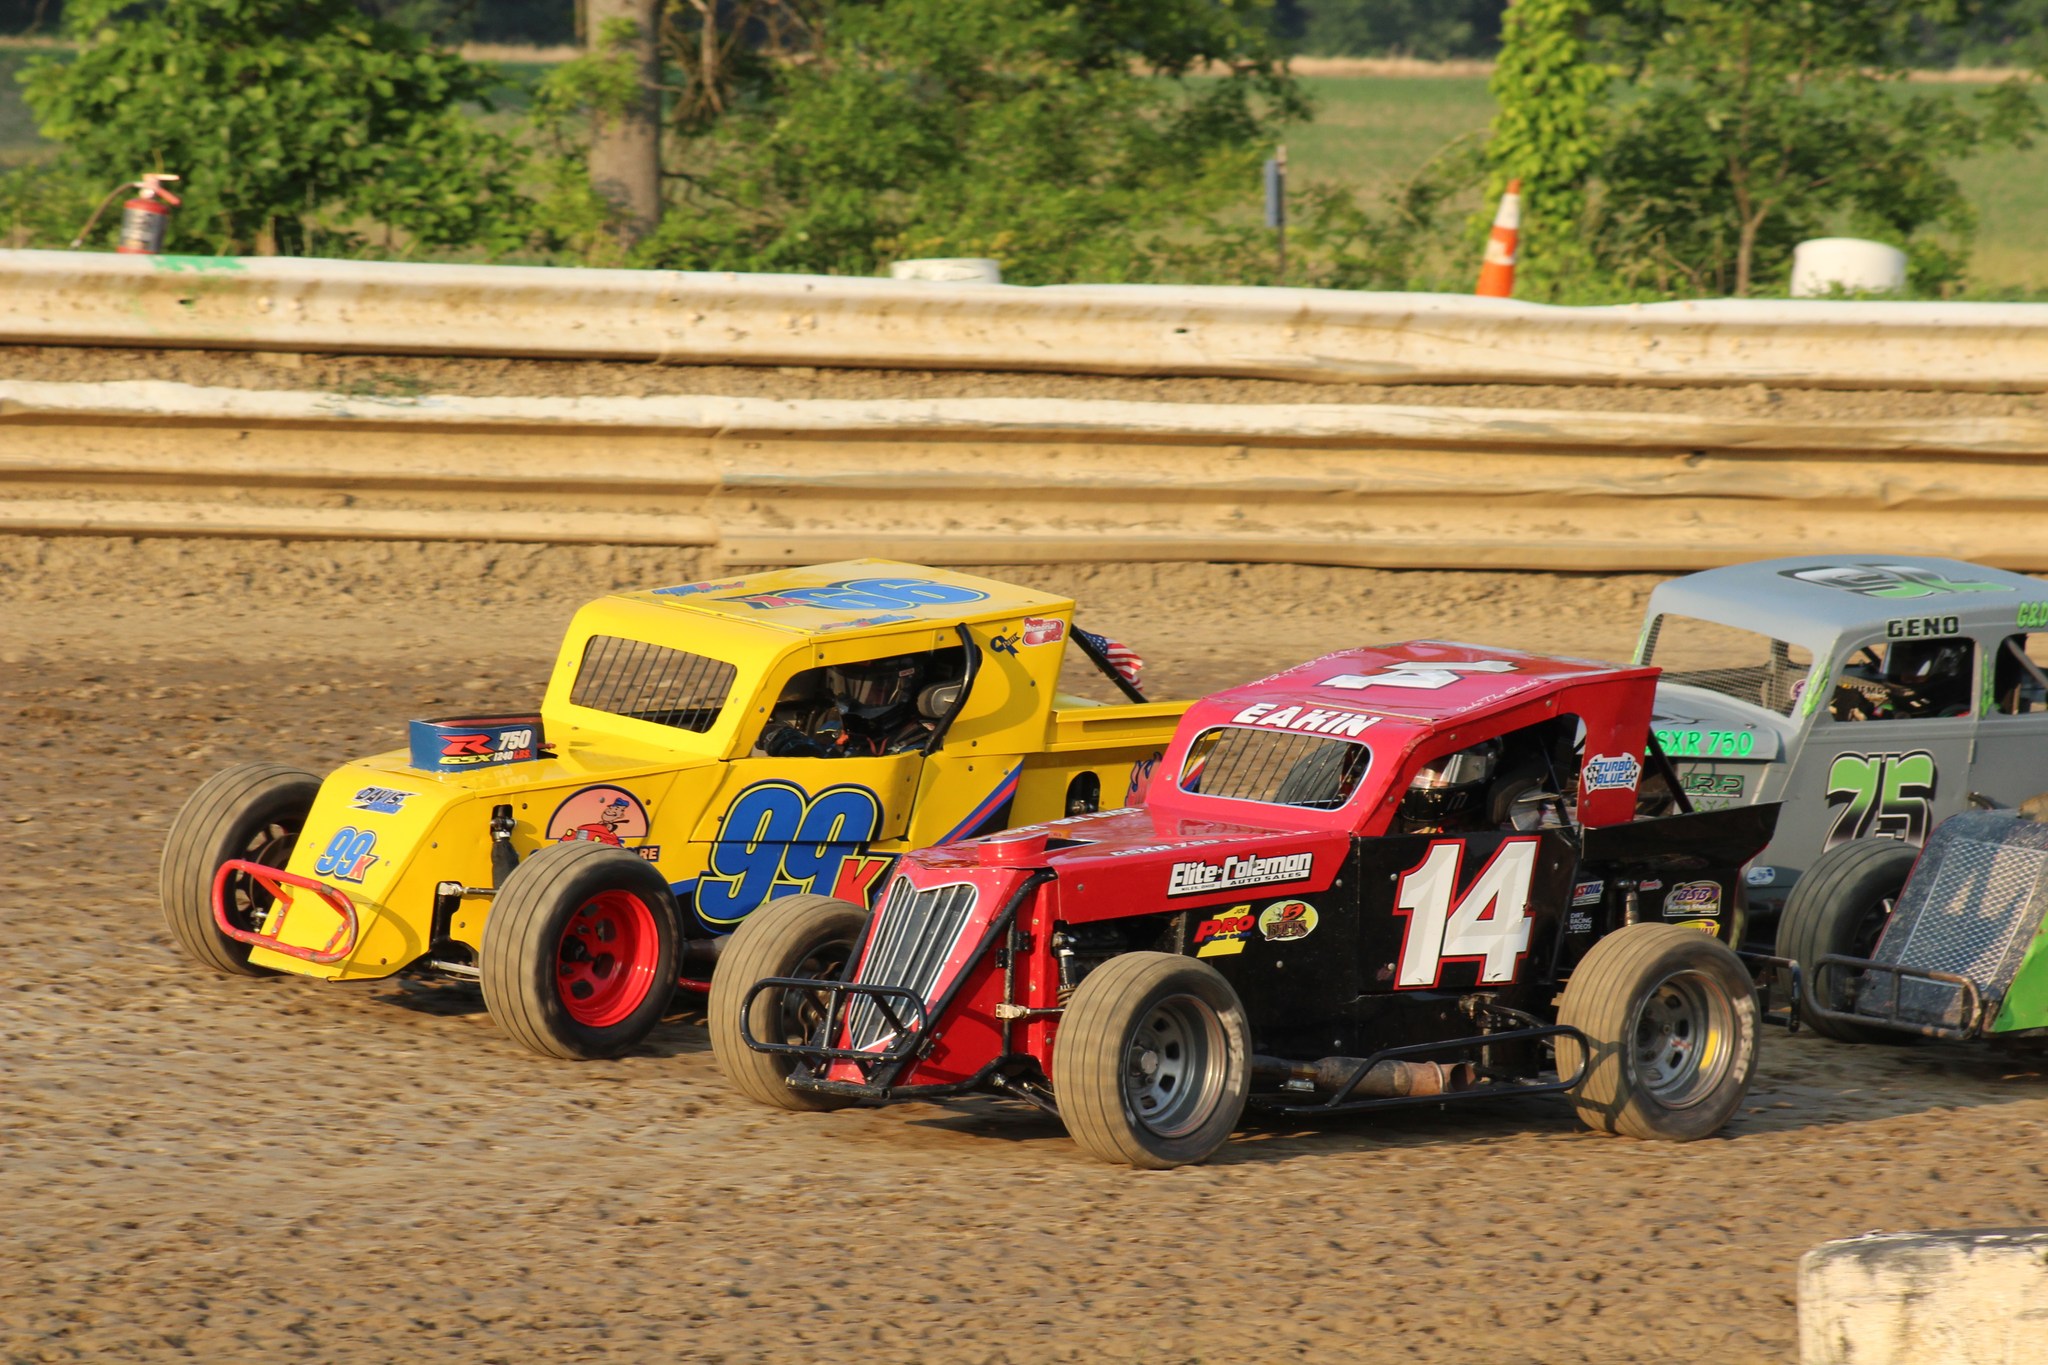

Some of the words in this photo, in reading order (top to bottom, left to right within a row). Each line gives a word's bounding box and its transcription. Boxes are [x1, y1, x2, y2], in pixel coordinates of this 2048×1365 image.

[1887, 616, 1960, 638] GENO
[1314, 660, 1523, 690] 14
[1231, 703, 1383, 737] EAKIN
[499, 730, 531, 750] 750
[1645, 729, 1702, 756] SXR
[1707, 730, 1754, 756] 750
[439, 754, 494, 764] GSX
[494, 750, 513, 761] 1240
[1591, 761, 1632, 772] TURBO
[1596, 772, 1632, 784] BLUE
[354, 787, 406, 804] DAVIS
[1822, 749, 1938, 854] 75
[315, 826, 379, 884] 99K
[693, 779, 895, 932] 99K
[1168, 861, 1220, 894] Elite
[1220, 852, 1313, 887] Coleman
[1230, 877, 1261, 886] AUTO
[1264, 871, 1302, 881] SALES
[1676, 888, 1711, 901] BSB
[1396, 838, 1540, 987] 14
[1193, 915, 1255, 943] PRO
